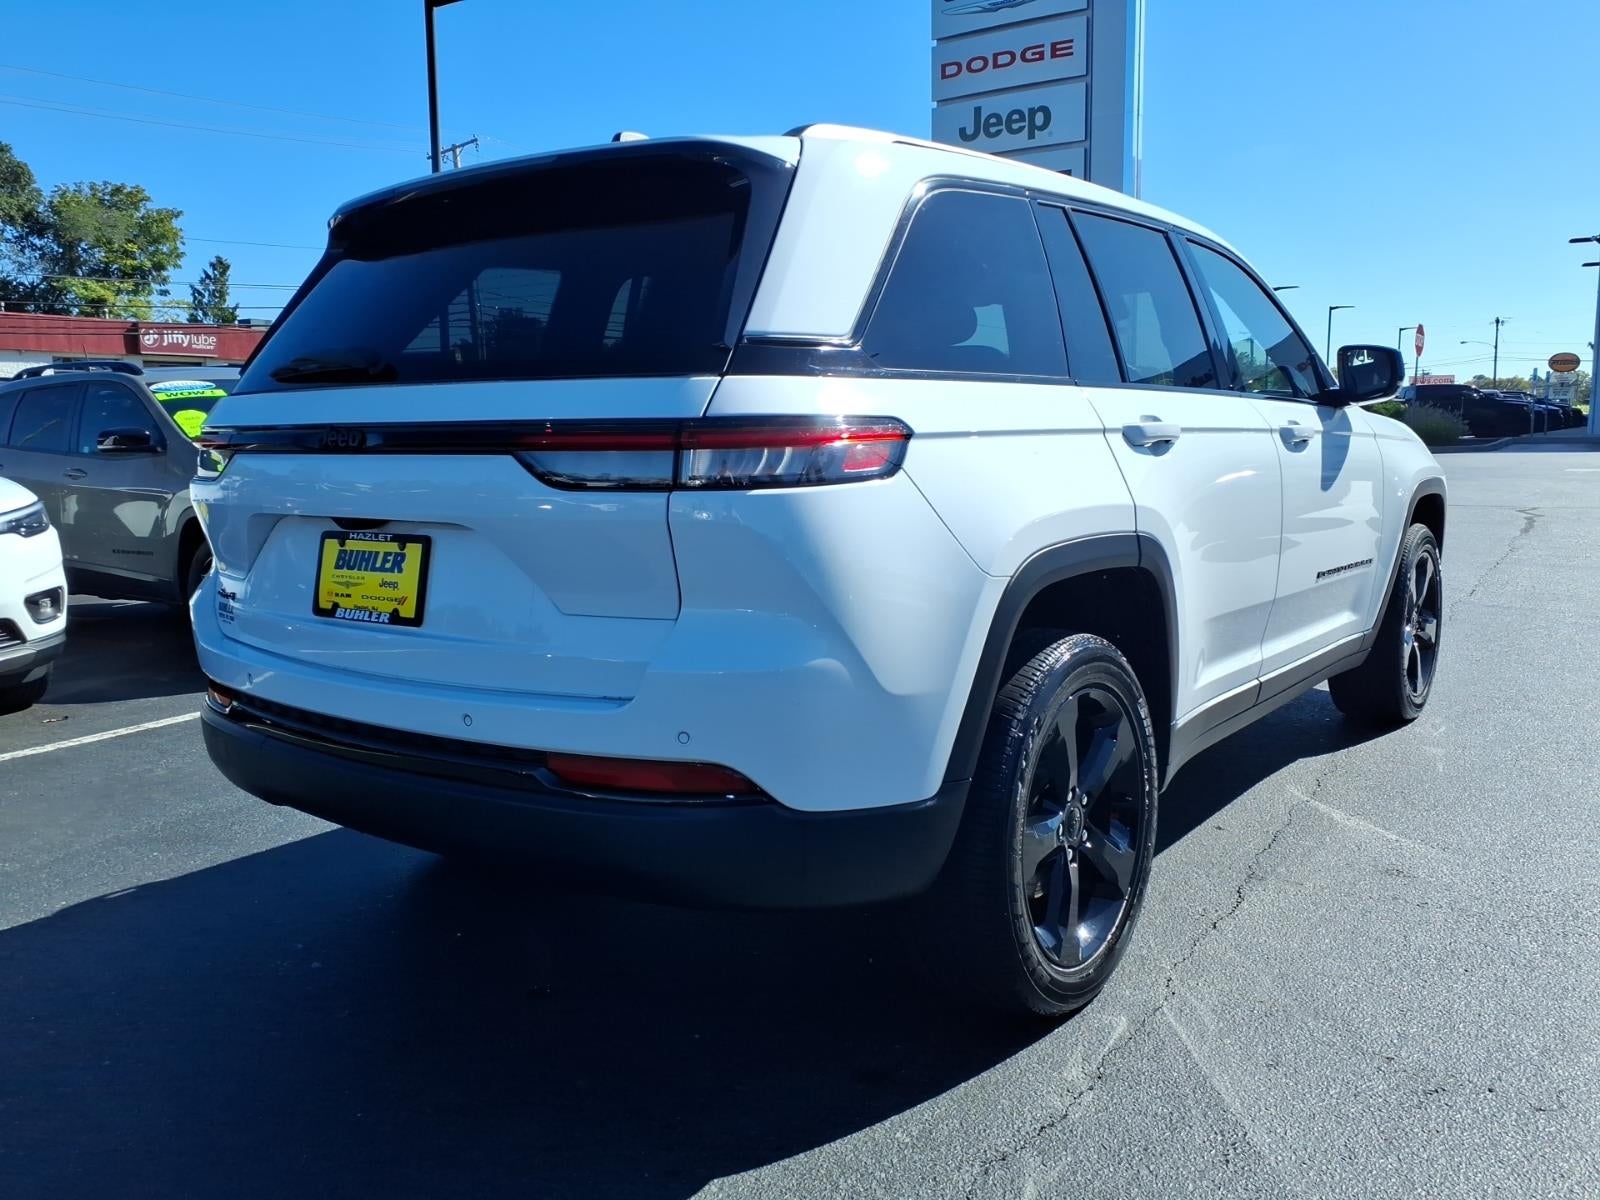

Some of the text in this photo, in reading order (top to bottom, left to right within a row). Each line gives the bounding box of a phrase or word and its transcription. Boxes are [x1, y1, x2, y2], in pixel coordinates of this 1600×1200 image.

[940, 39, 1074, 80] DODGE
[958, 104, 1052, 142] Jeep
[163, 330, 217, 347] jiffy lube
[349, 532, 393, 541] HAZLET
[334, 549, 407, 574] BUHLER
[378, 578, 399, 591] Jeep
[361, 594, 401, 605] DODGE
[335, 608, 390, 623] BUHLER
